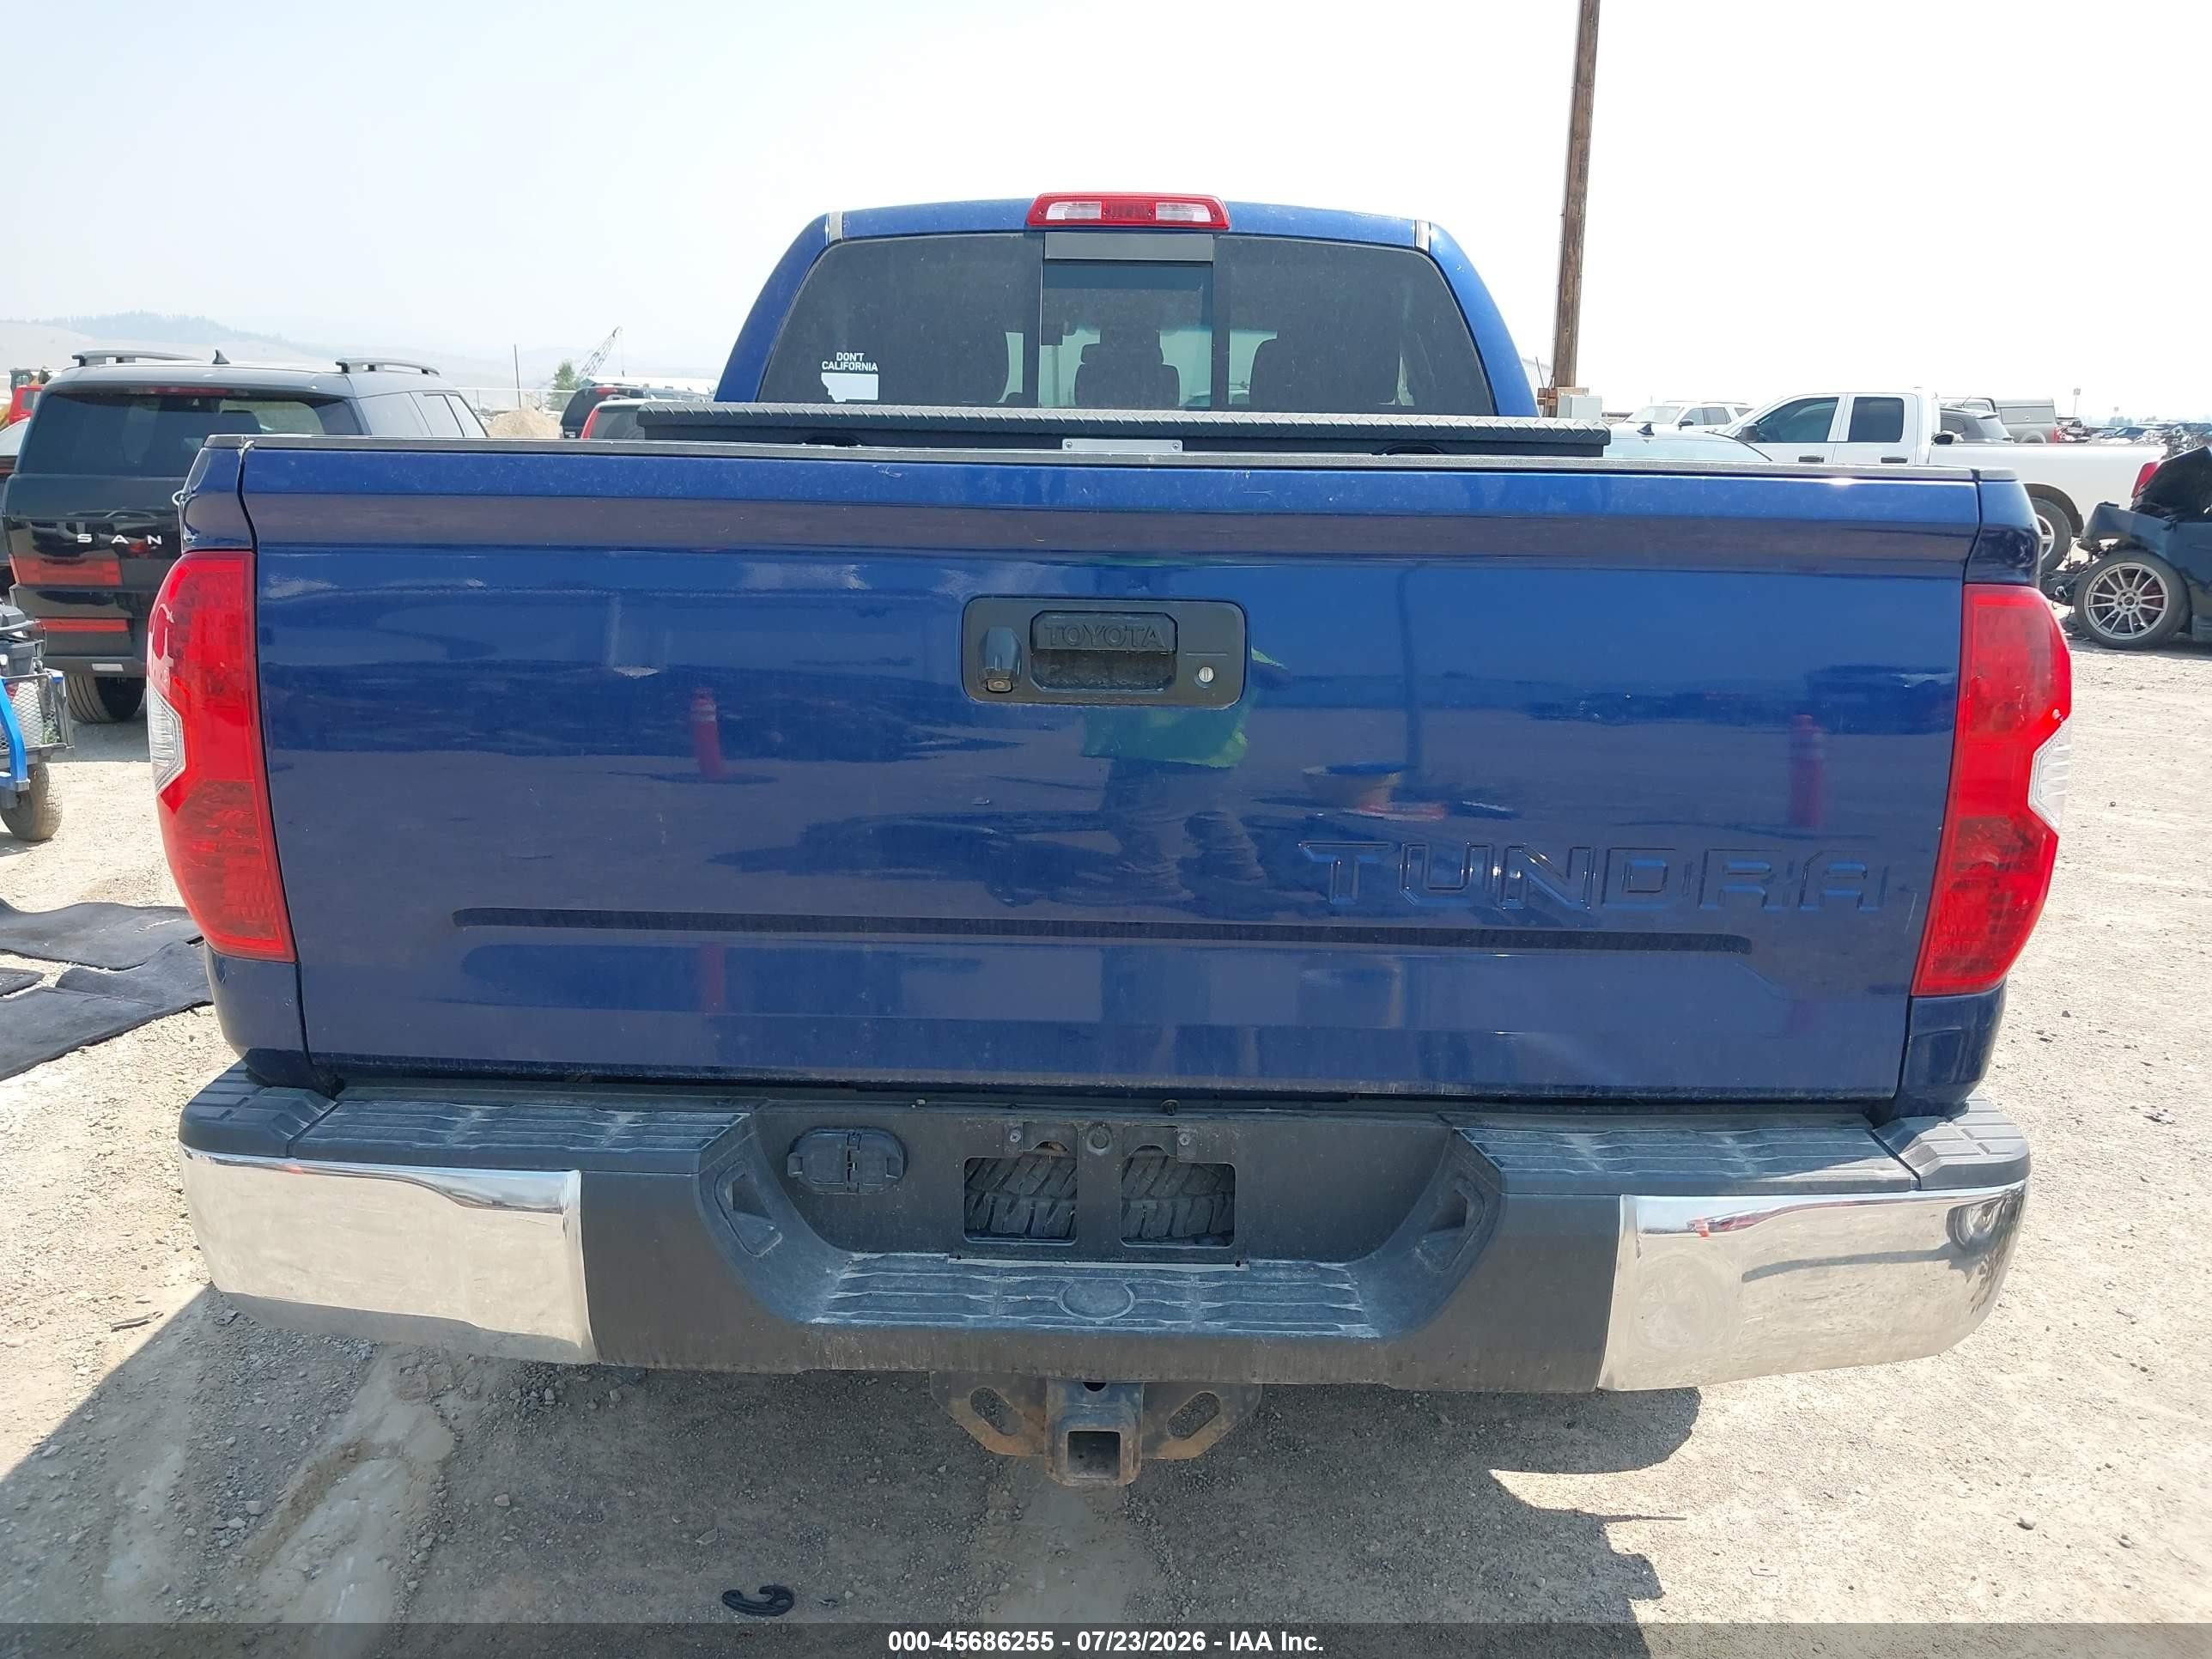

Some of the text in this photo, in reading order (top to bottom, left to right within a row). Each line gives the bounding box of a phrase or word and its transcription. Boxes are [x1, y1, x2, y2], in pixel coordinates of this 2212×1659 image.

[836, 351, 865, 362] DON'T
[822, 361, 878, 372] CALIFORNIA
[76, 533, 162, 545] SAN
[1044, 623, 1165, 648] TOYOTA
[1297, 839, 1888, 913] TUNDRA
